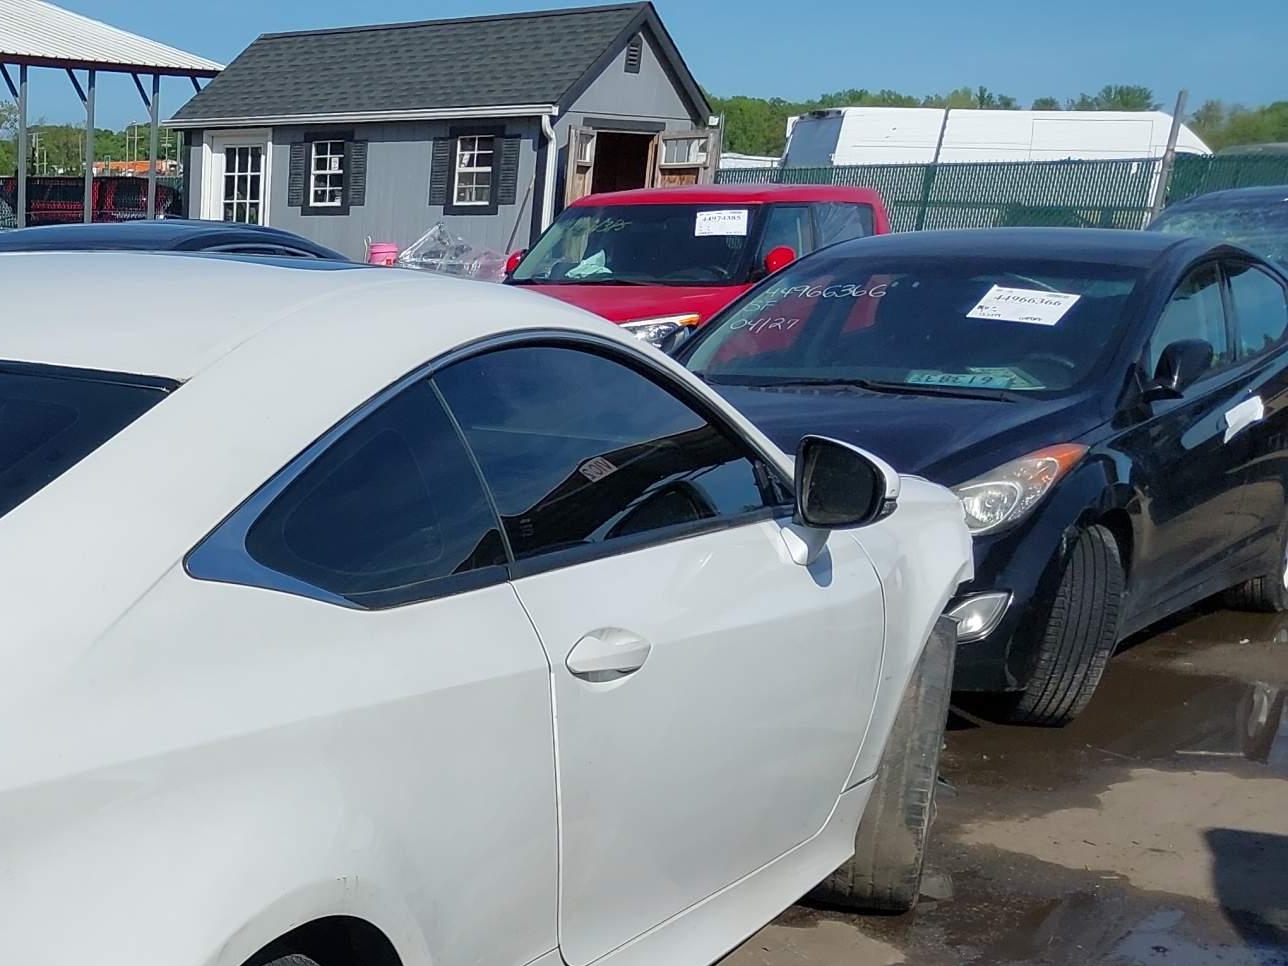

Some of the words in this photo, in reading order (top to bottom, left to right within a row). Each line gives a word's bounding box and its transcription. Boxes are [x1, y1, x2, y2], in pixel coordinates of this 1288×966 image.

[765, 283, 889, 299] 44966366
[994, 294, 1062, 306] 44966366
[730, 317, 800, 334] 04/27
